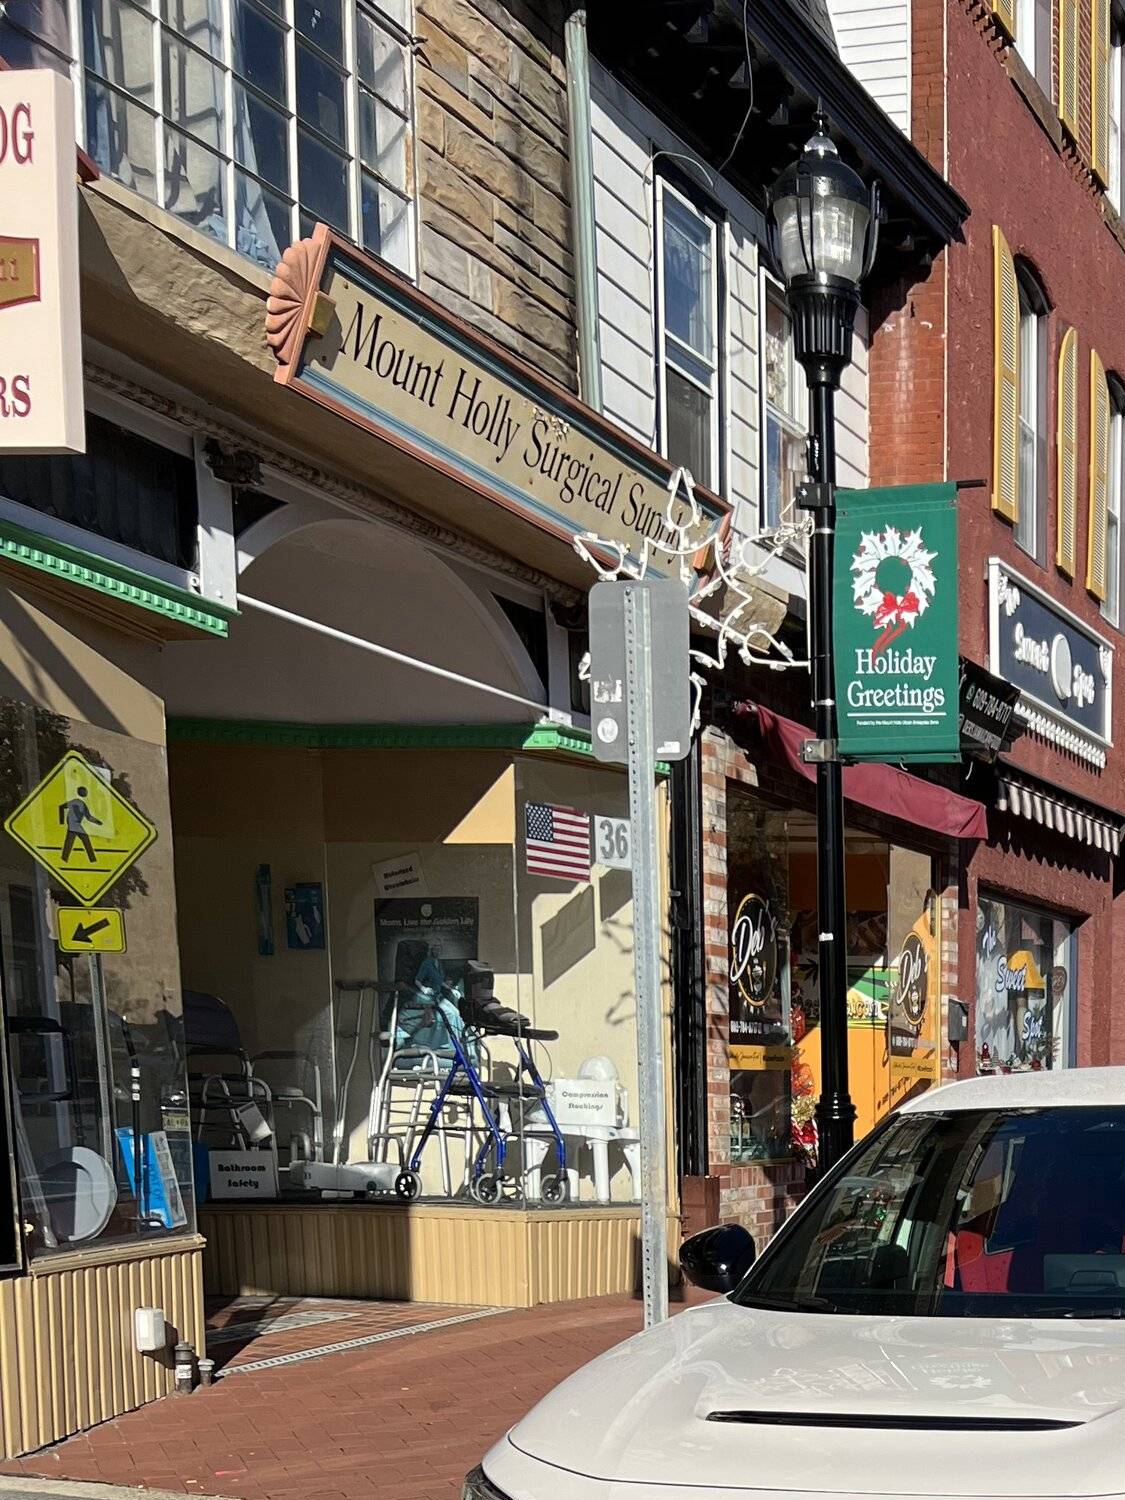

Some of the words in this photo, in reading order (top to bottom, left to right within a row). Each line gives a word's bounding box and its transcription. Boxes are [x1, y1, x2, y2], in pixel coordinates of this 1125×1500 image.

[0, 102, 34, 165] G
[338, 301, 445, 408] Mount
[446, 368, 520, 463] Holly
[523, 417, 623, 504] Surgical
[1014, 622, 1050, 673] Sweet
[855, 648, 937, 680] Holiday
[847, 680, 946, 712] Greetings
[600, 819, 628, 860] 36
[562, 1091, 609, 1099] Compression
[568, 1103, 604, 1111] Stockings
[217, 1164, 266, 1172] Bathroom
[227, 1179, 260, 1189] Safety
